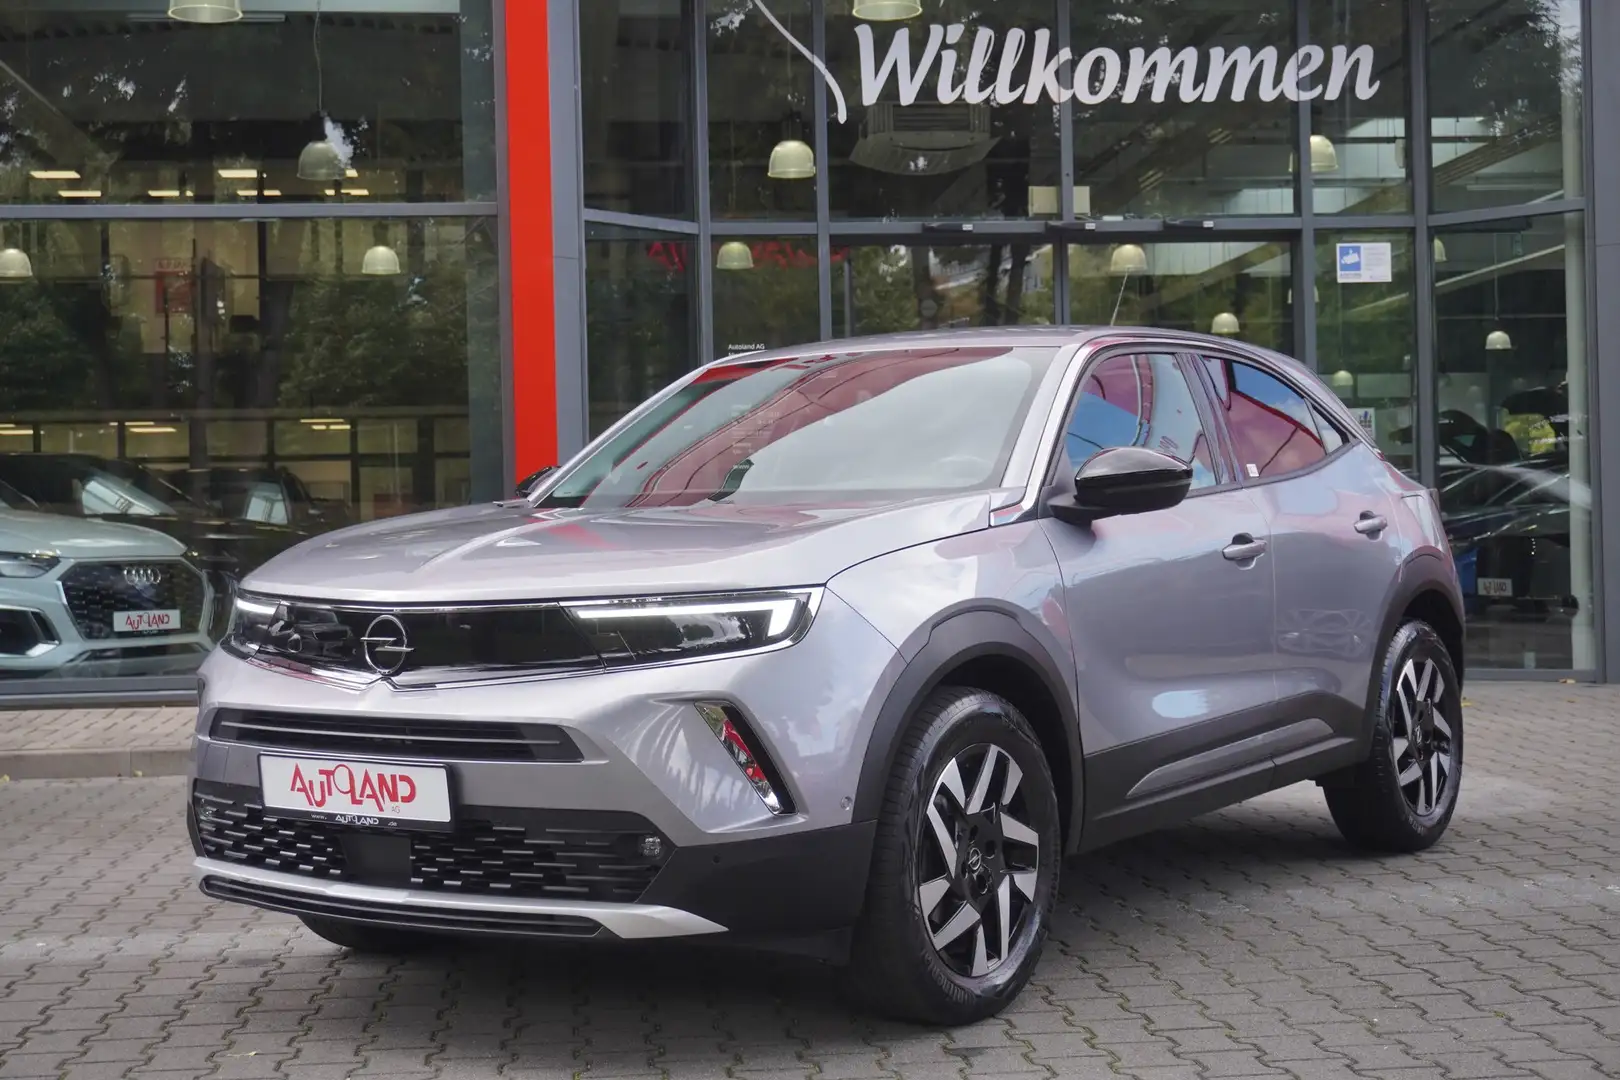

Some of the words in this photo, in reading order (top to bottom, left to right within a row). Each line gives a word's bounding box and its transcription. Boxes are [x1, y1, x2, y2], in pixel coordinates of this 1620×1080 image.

[854, 23, 1381, 107] Willkommen
[290, 762, 417, 812] AUTOLAND
[335, 814, 379, 826] AUTOLAND
